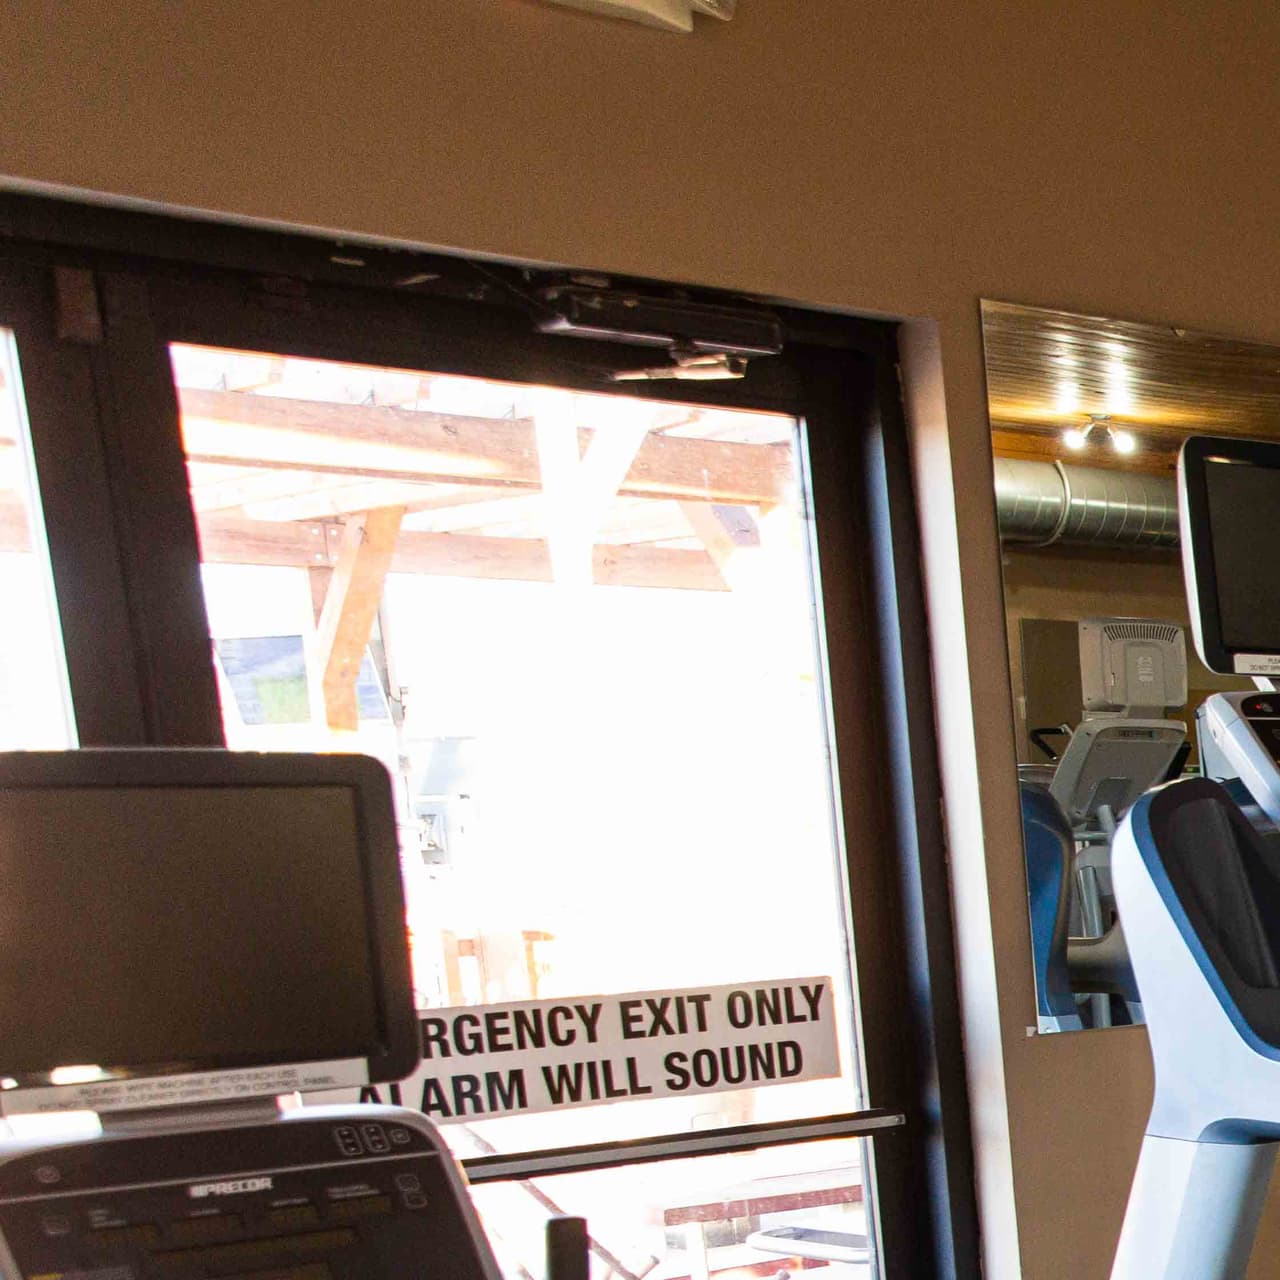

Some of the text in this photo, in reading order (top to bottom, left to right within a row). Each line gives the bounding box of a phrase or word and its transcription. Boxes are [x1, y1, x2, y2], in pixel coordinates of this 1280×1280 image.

[421, 984, 825, 1060] RGENCY EXIT ONLY
[540, 1057, 653, 1105] WILL
[664, 1039, 805, 1092] SOUND
[206, 1176, 274, 1196] PRECOR
